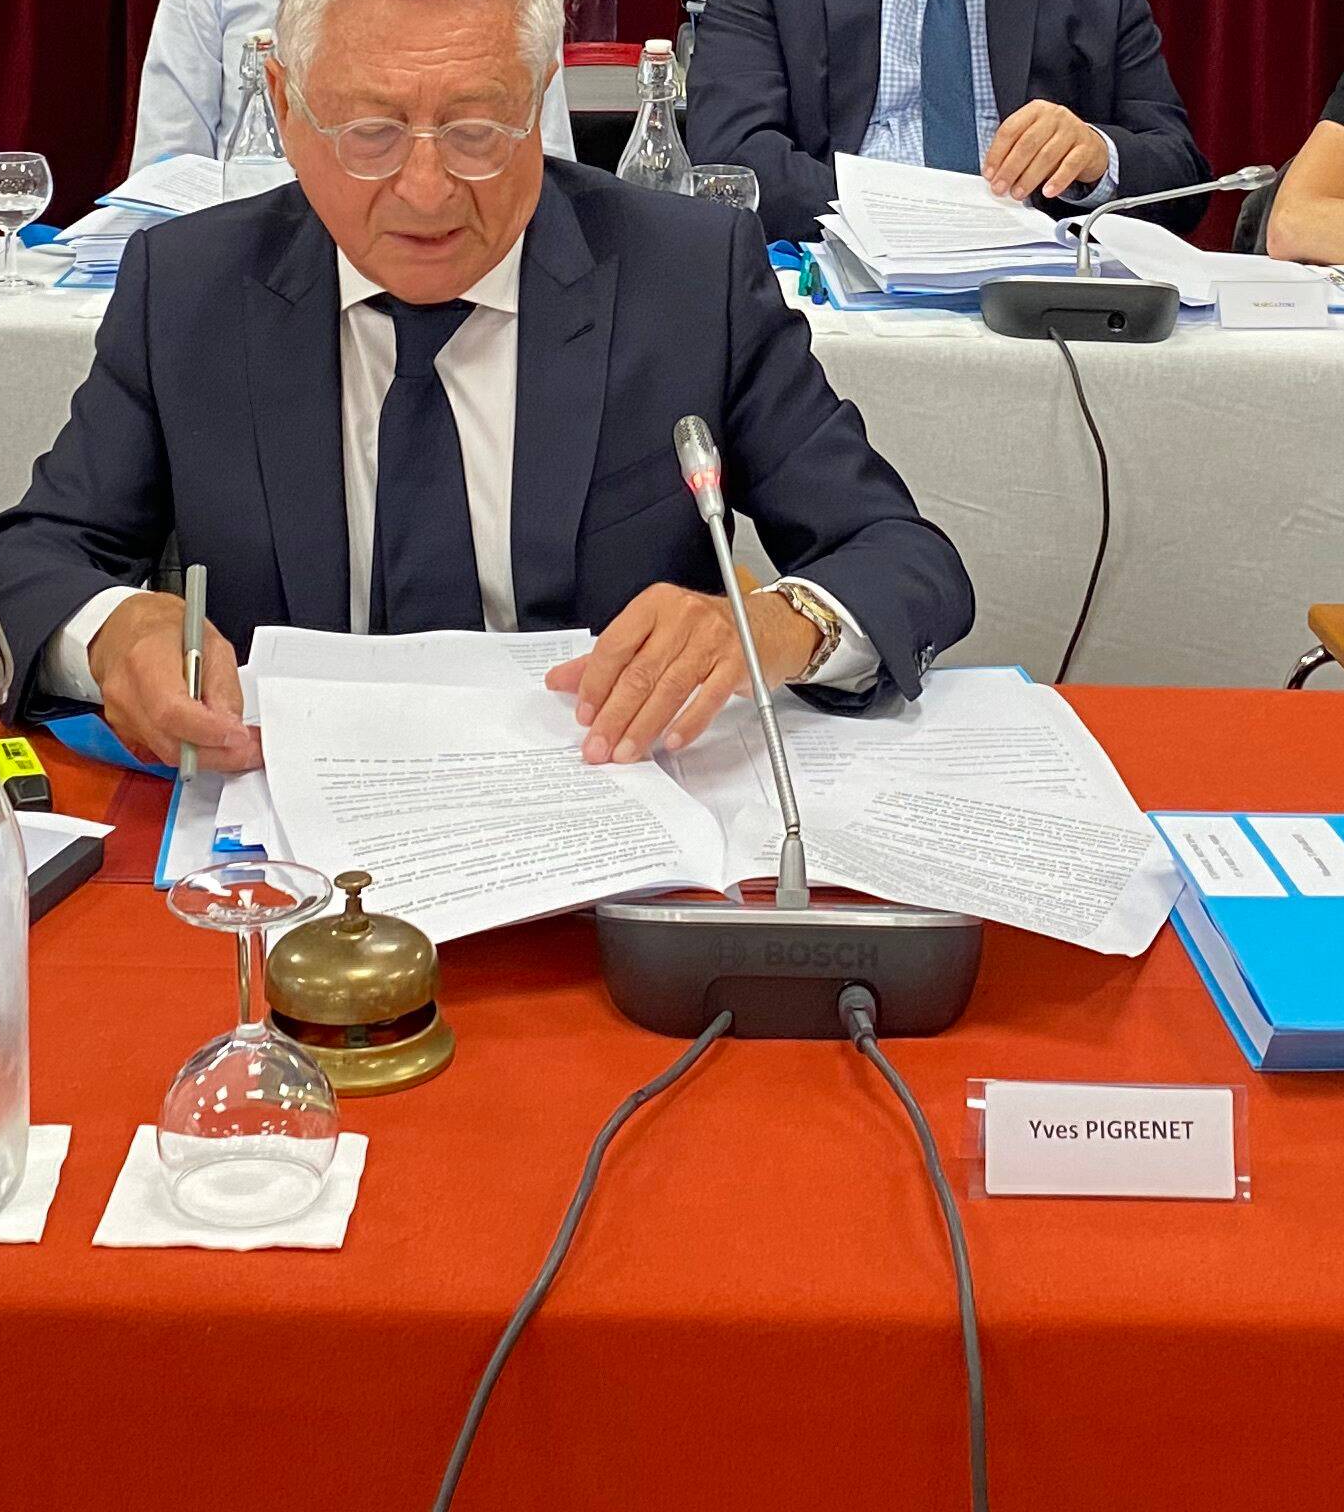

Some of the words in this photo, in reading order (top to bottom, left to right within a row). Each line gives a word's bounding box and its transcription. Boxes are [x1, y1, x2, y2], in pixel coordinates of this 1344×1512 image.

[765, 940, 879, 969] BOSCH
[1029, 1120, 1079, 1139] Yves
[1086, 1120, 1194, 1140] PIGRENET
